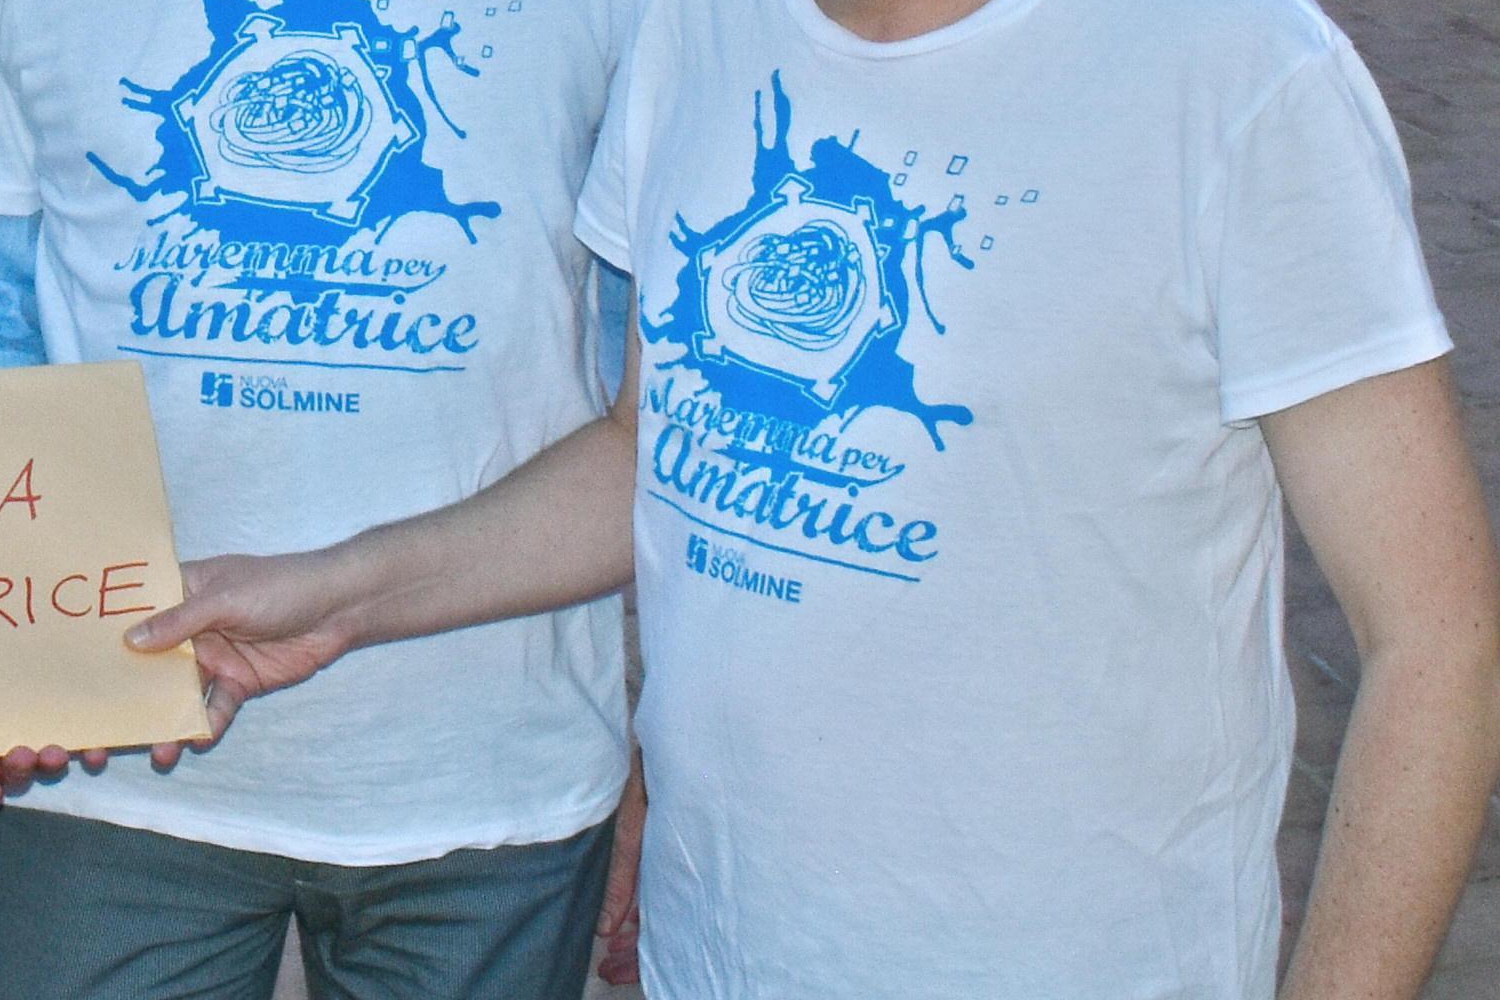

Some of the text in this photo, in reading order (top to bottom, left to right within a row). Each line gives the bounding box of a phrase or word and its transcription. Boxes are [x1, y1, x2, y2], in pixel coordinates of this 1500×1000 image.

[113, 230, 446, 286] Maremma per
[129, 271, 480, 353] Amatrice
[239, 375, 288, 388] NUOVA
[239, 388, 360, 413] SOLMINE
[640, 377, 905, 472] Maremma per
[653, 424, 938, 562] Amatrice
[708, 556, 803, 604] SOLMINE
